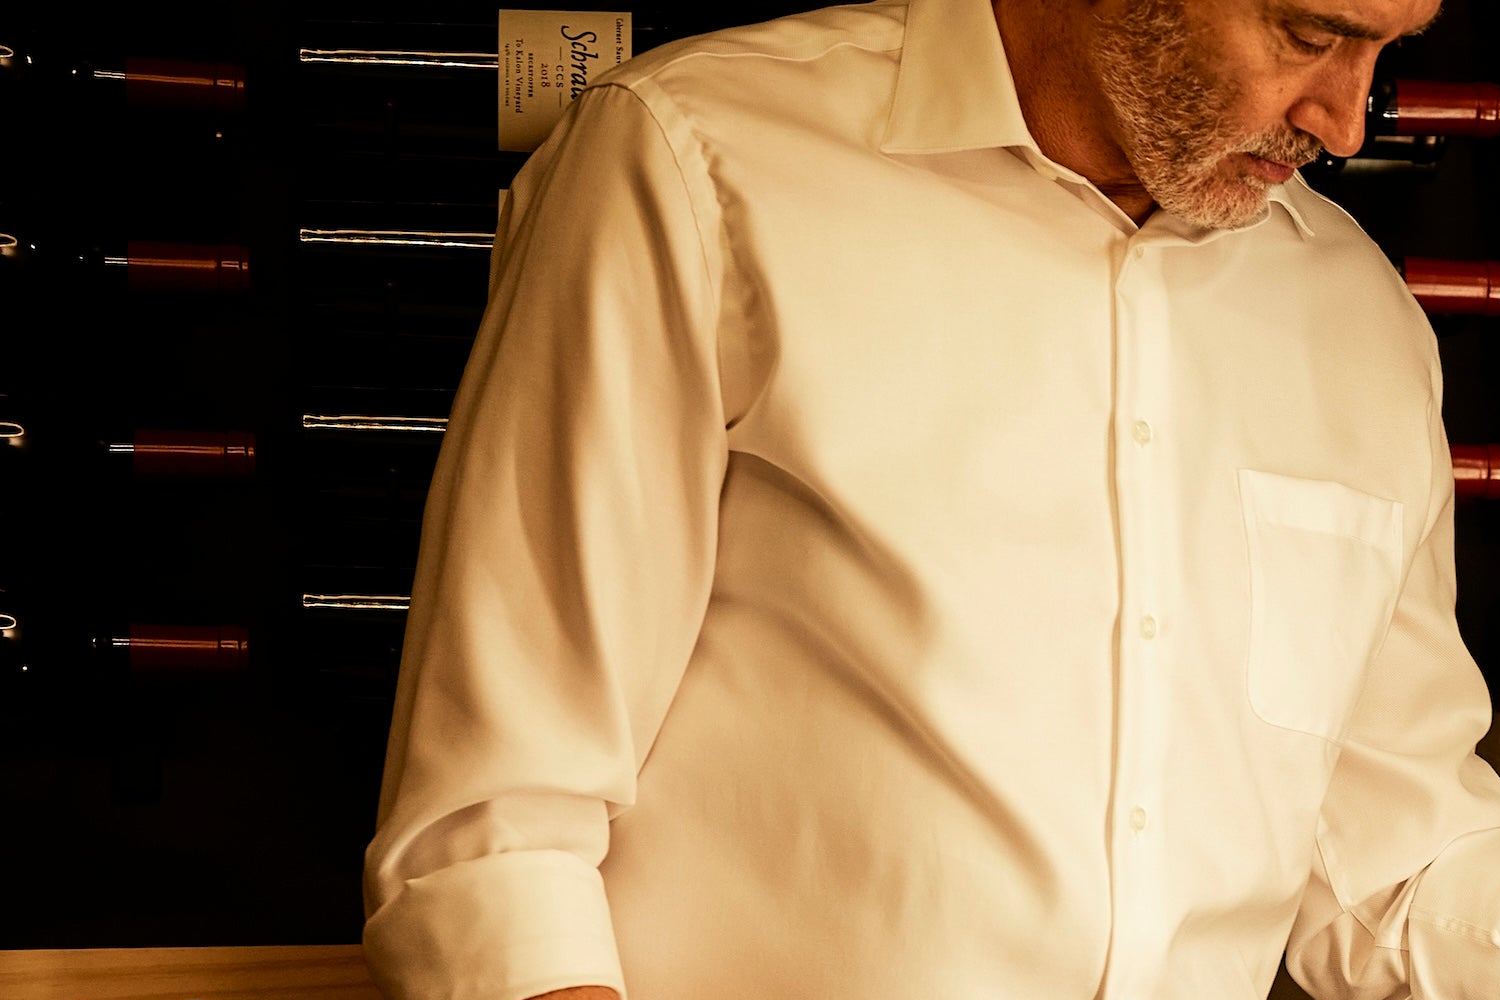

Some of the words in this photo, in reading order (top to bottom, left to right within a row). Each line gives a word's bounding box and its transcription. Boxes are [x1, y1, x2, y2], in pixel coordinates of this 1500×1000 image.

[515, 39, 524, 48] To
[515, 50, 524, 74] Kalon
[560, 25, 599, 100] Schra
[541, 63, 550, 88] 2018
[555, 65, 564, 88] CCS
[514, 77, 524, 113] Vineyard
